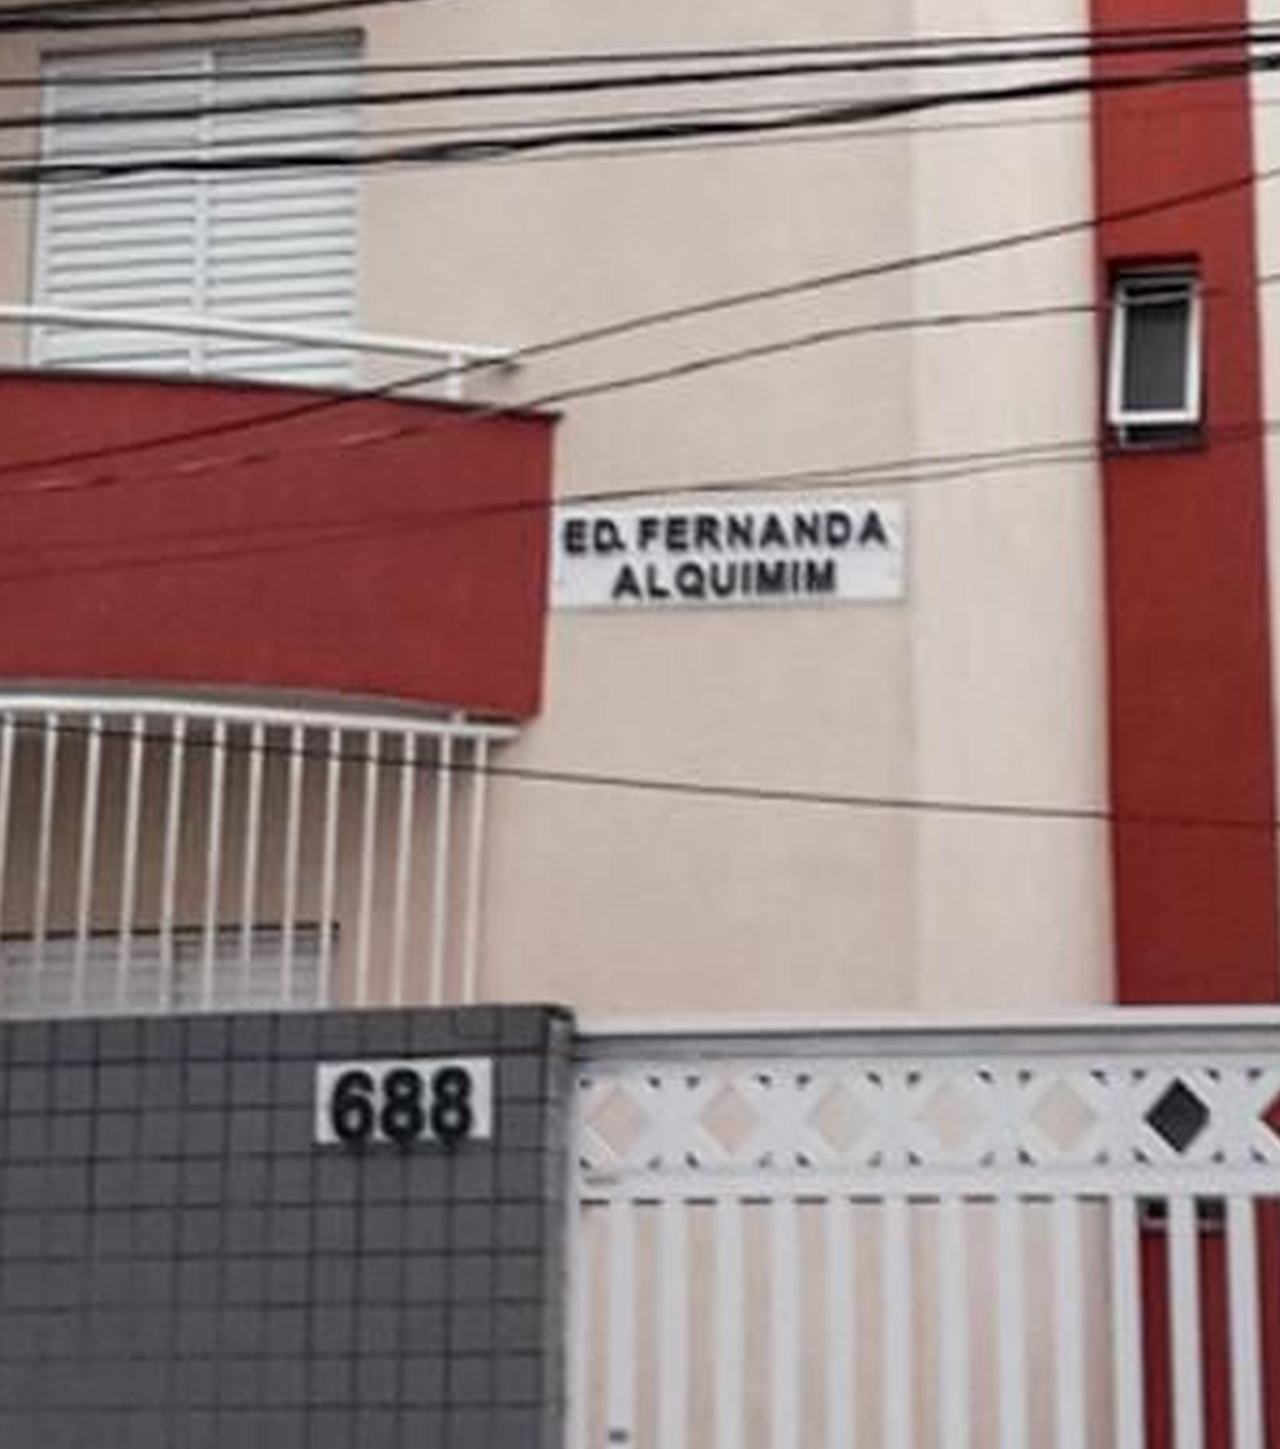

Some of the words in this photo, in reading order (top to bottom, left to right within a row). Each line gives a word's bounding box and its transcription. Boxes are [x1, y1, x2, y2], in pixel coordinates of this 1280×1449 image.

[637, 510, 889, 552] FERNANDA
[612, 558, 837, 599] ALQUIMIM
[331, 1065, 474, 1141] 688
